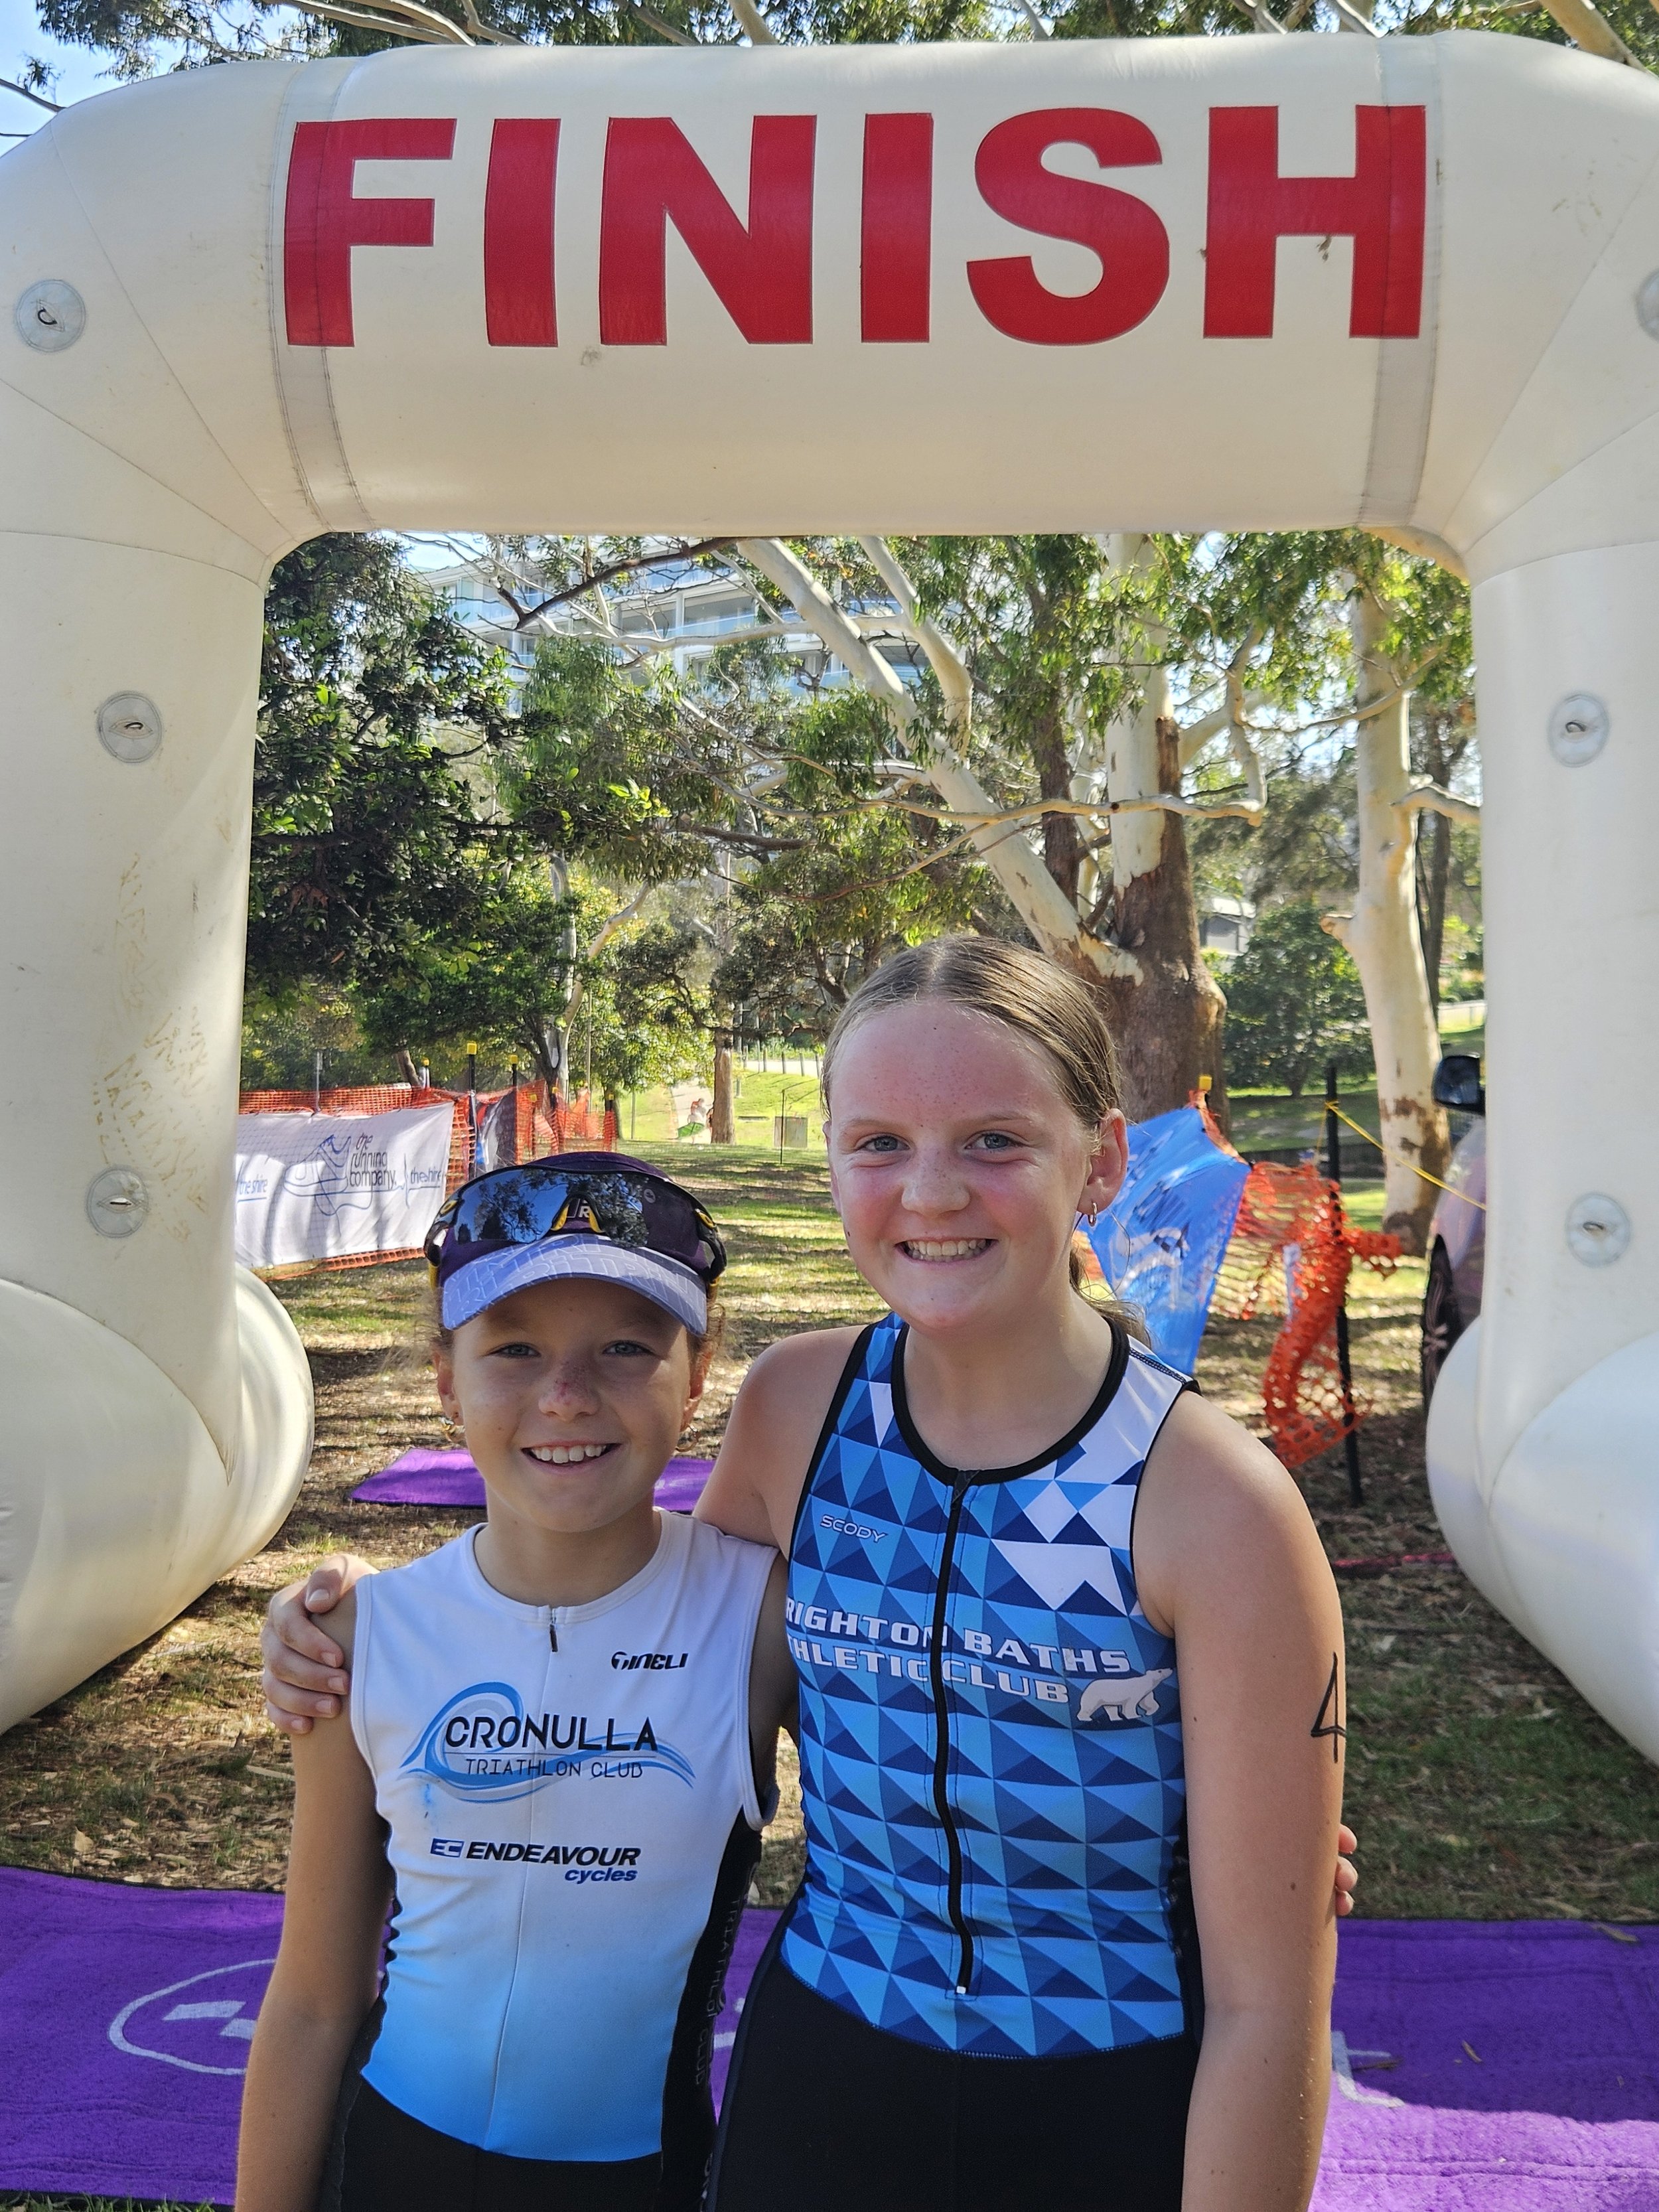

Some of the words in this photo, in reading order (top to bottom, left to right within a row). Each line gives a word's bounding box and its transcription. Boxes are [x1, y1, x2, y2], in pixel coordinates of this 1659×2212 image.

[284, 105, 1427, 346] FINISH
[351, 1151, 388, 1169] running
[820, 1514, 887, 1543] SCODY
[786, 1597, 948, 1649] RIGHTON
[964, 1628, 1131, 1674] BATHS
[787, 1632, 929, 1682] THLETIC
[942, 1659, 1069, 1704] CLUB
[1310, 1651, 1346, 1764] 4
[445, 1713, 659, 1751] CRONULLA
[466, 1757, 582, 1777] TRIATHLON
[591, 1761, 644, 1779] CLUB
[466, 1841, 642, 1867] ENDEAVOUR
[564, 1867, 638, 1885] cycles
